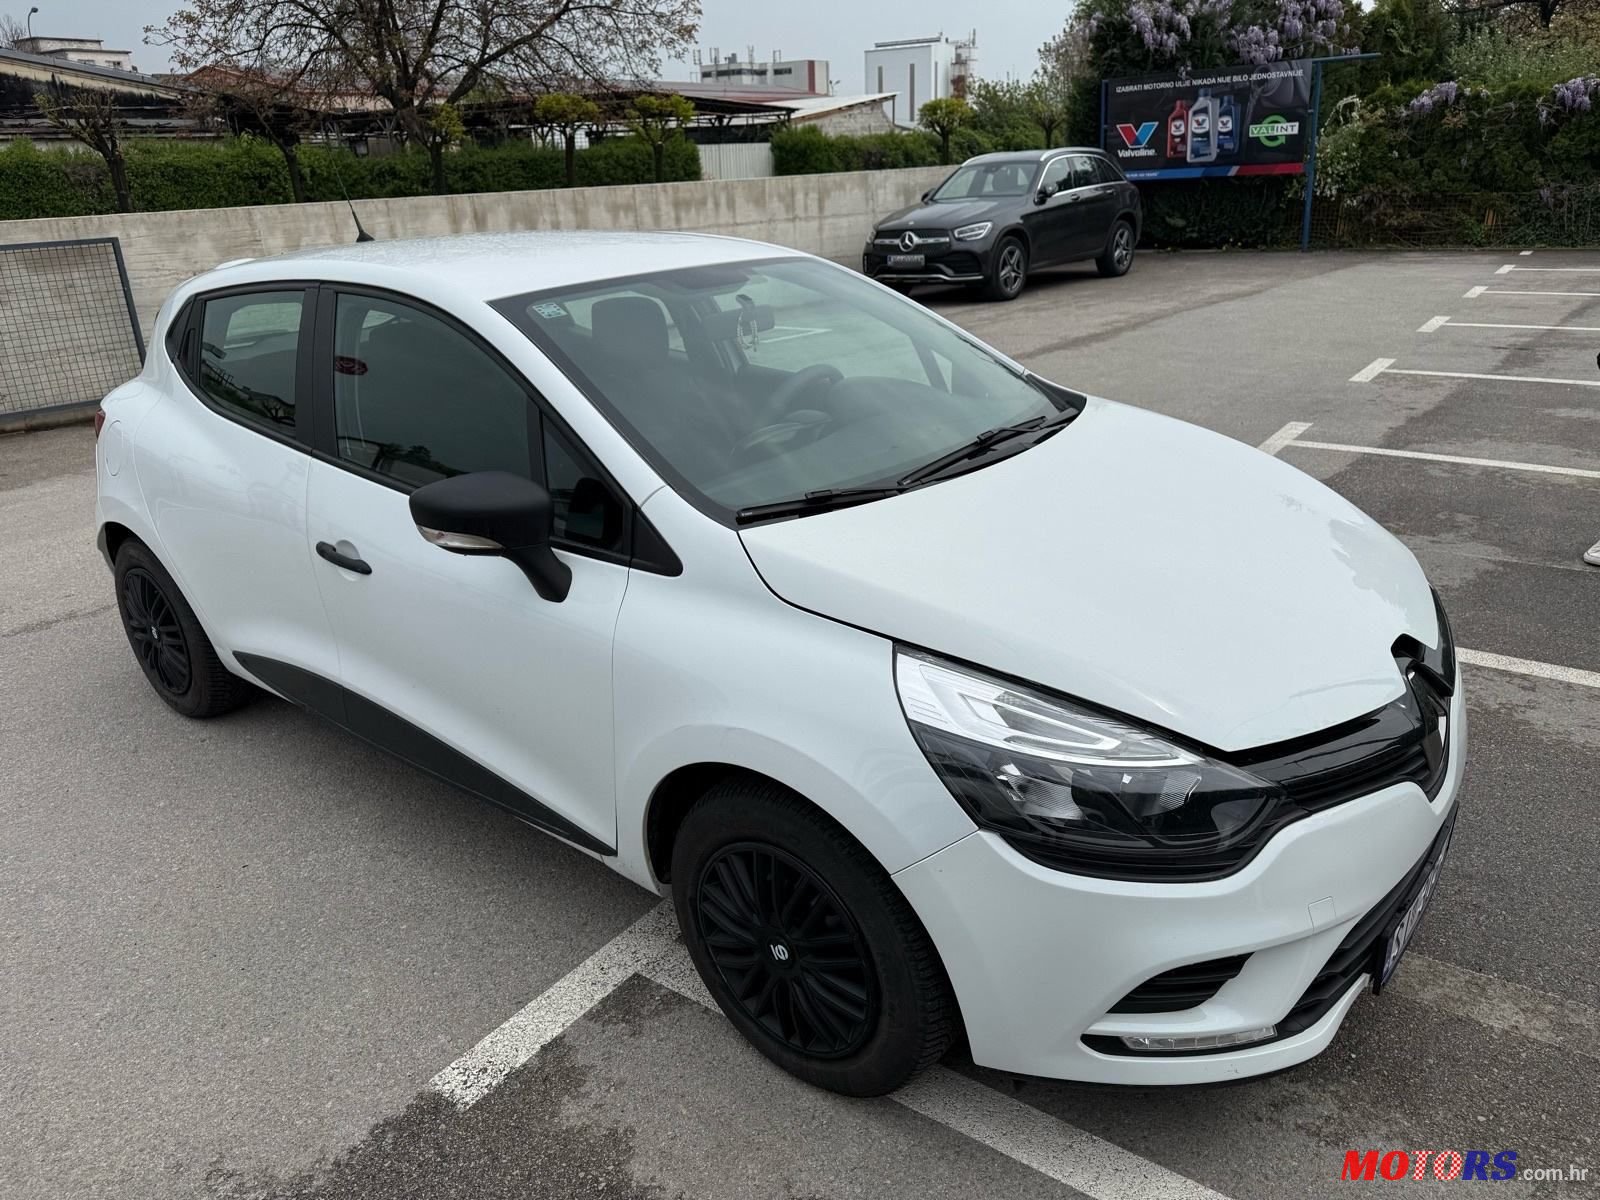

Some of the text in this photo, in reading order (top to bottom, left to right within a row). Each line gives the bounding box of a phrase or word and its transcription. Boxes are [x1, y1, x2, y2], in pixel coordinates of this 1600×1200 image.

[1115, 69, 1304, 93] IZABRATI MOTORNO ULJE NIKADA NIJE BILO JEDNOSTAVNIJE
[1251, 124, 1297, 136] VALINT
[1117, 148, 1156, 158] Valvoline
